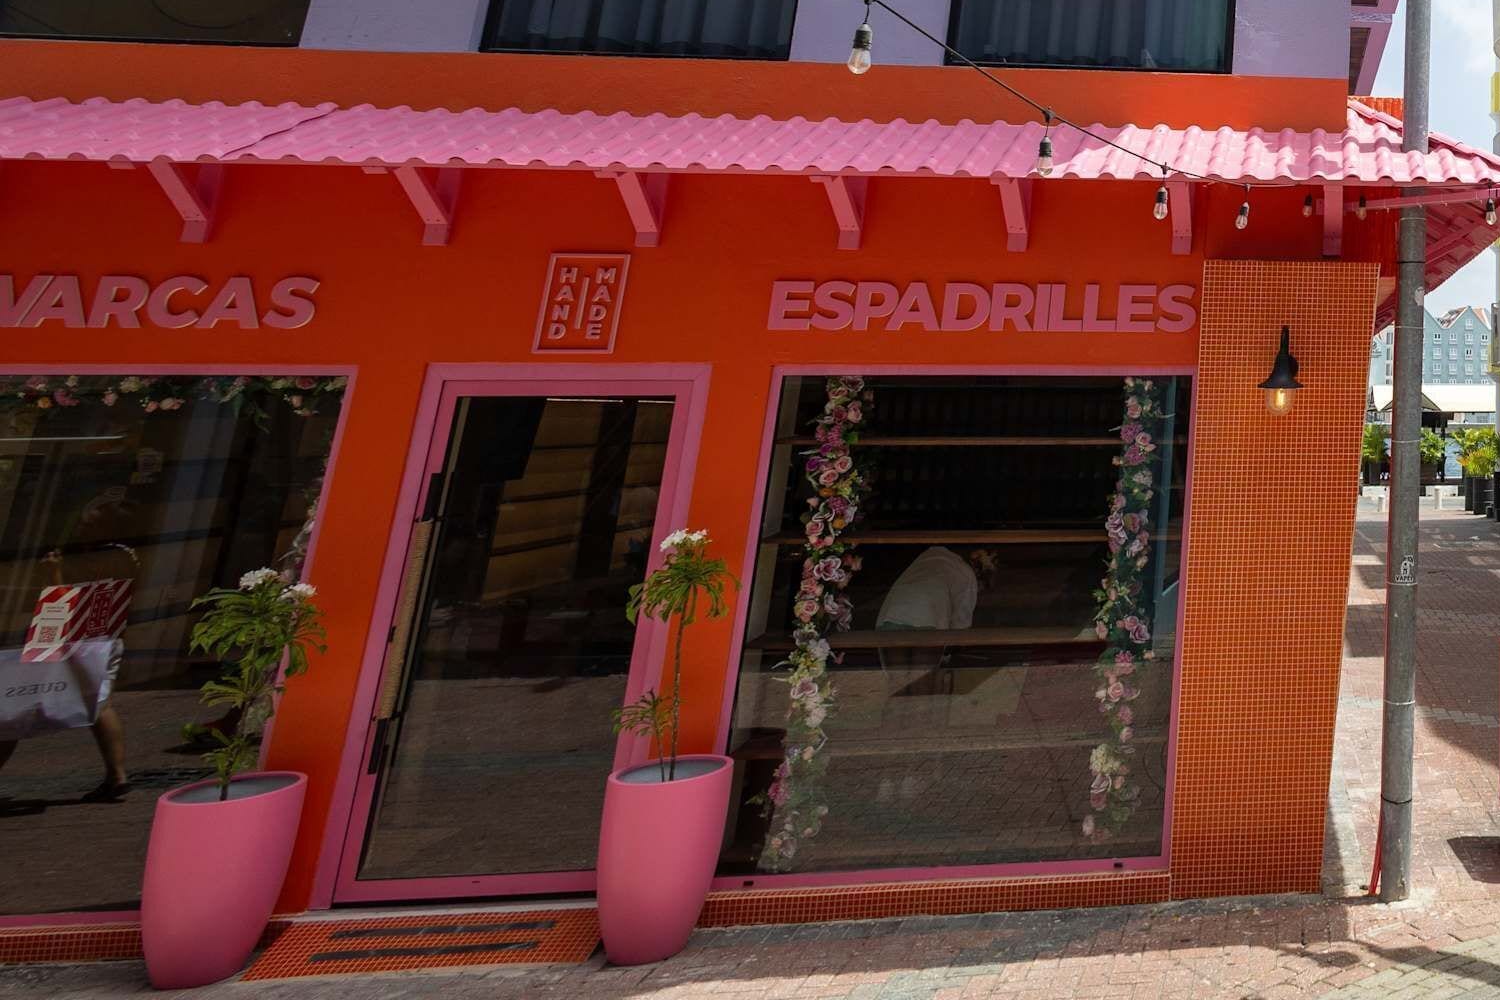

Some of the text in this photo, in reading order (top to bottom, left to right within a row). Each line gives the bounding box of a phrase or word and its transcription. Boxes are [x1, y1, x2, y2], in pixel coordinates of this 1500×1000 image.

[547, 266, 579, 340] HAND
[584, 266, 617, 340] MADE
[767, 280, 1197, 333] ESPADRILLES
